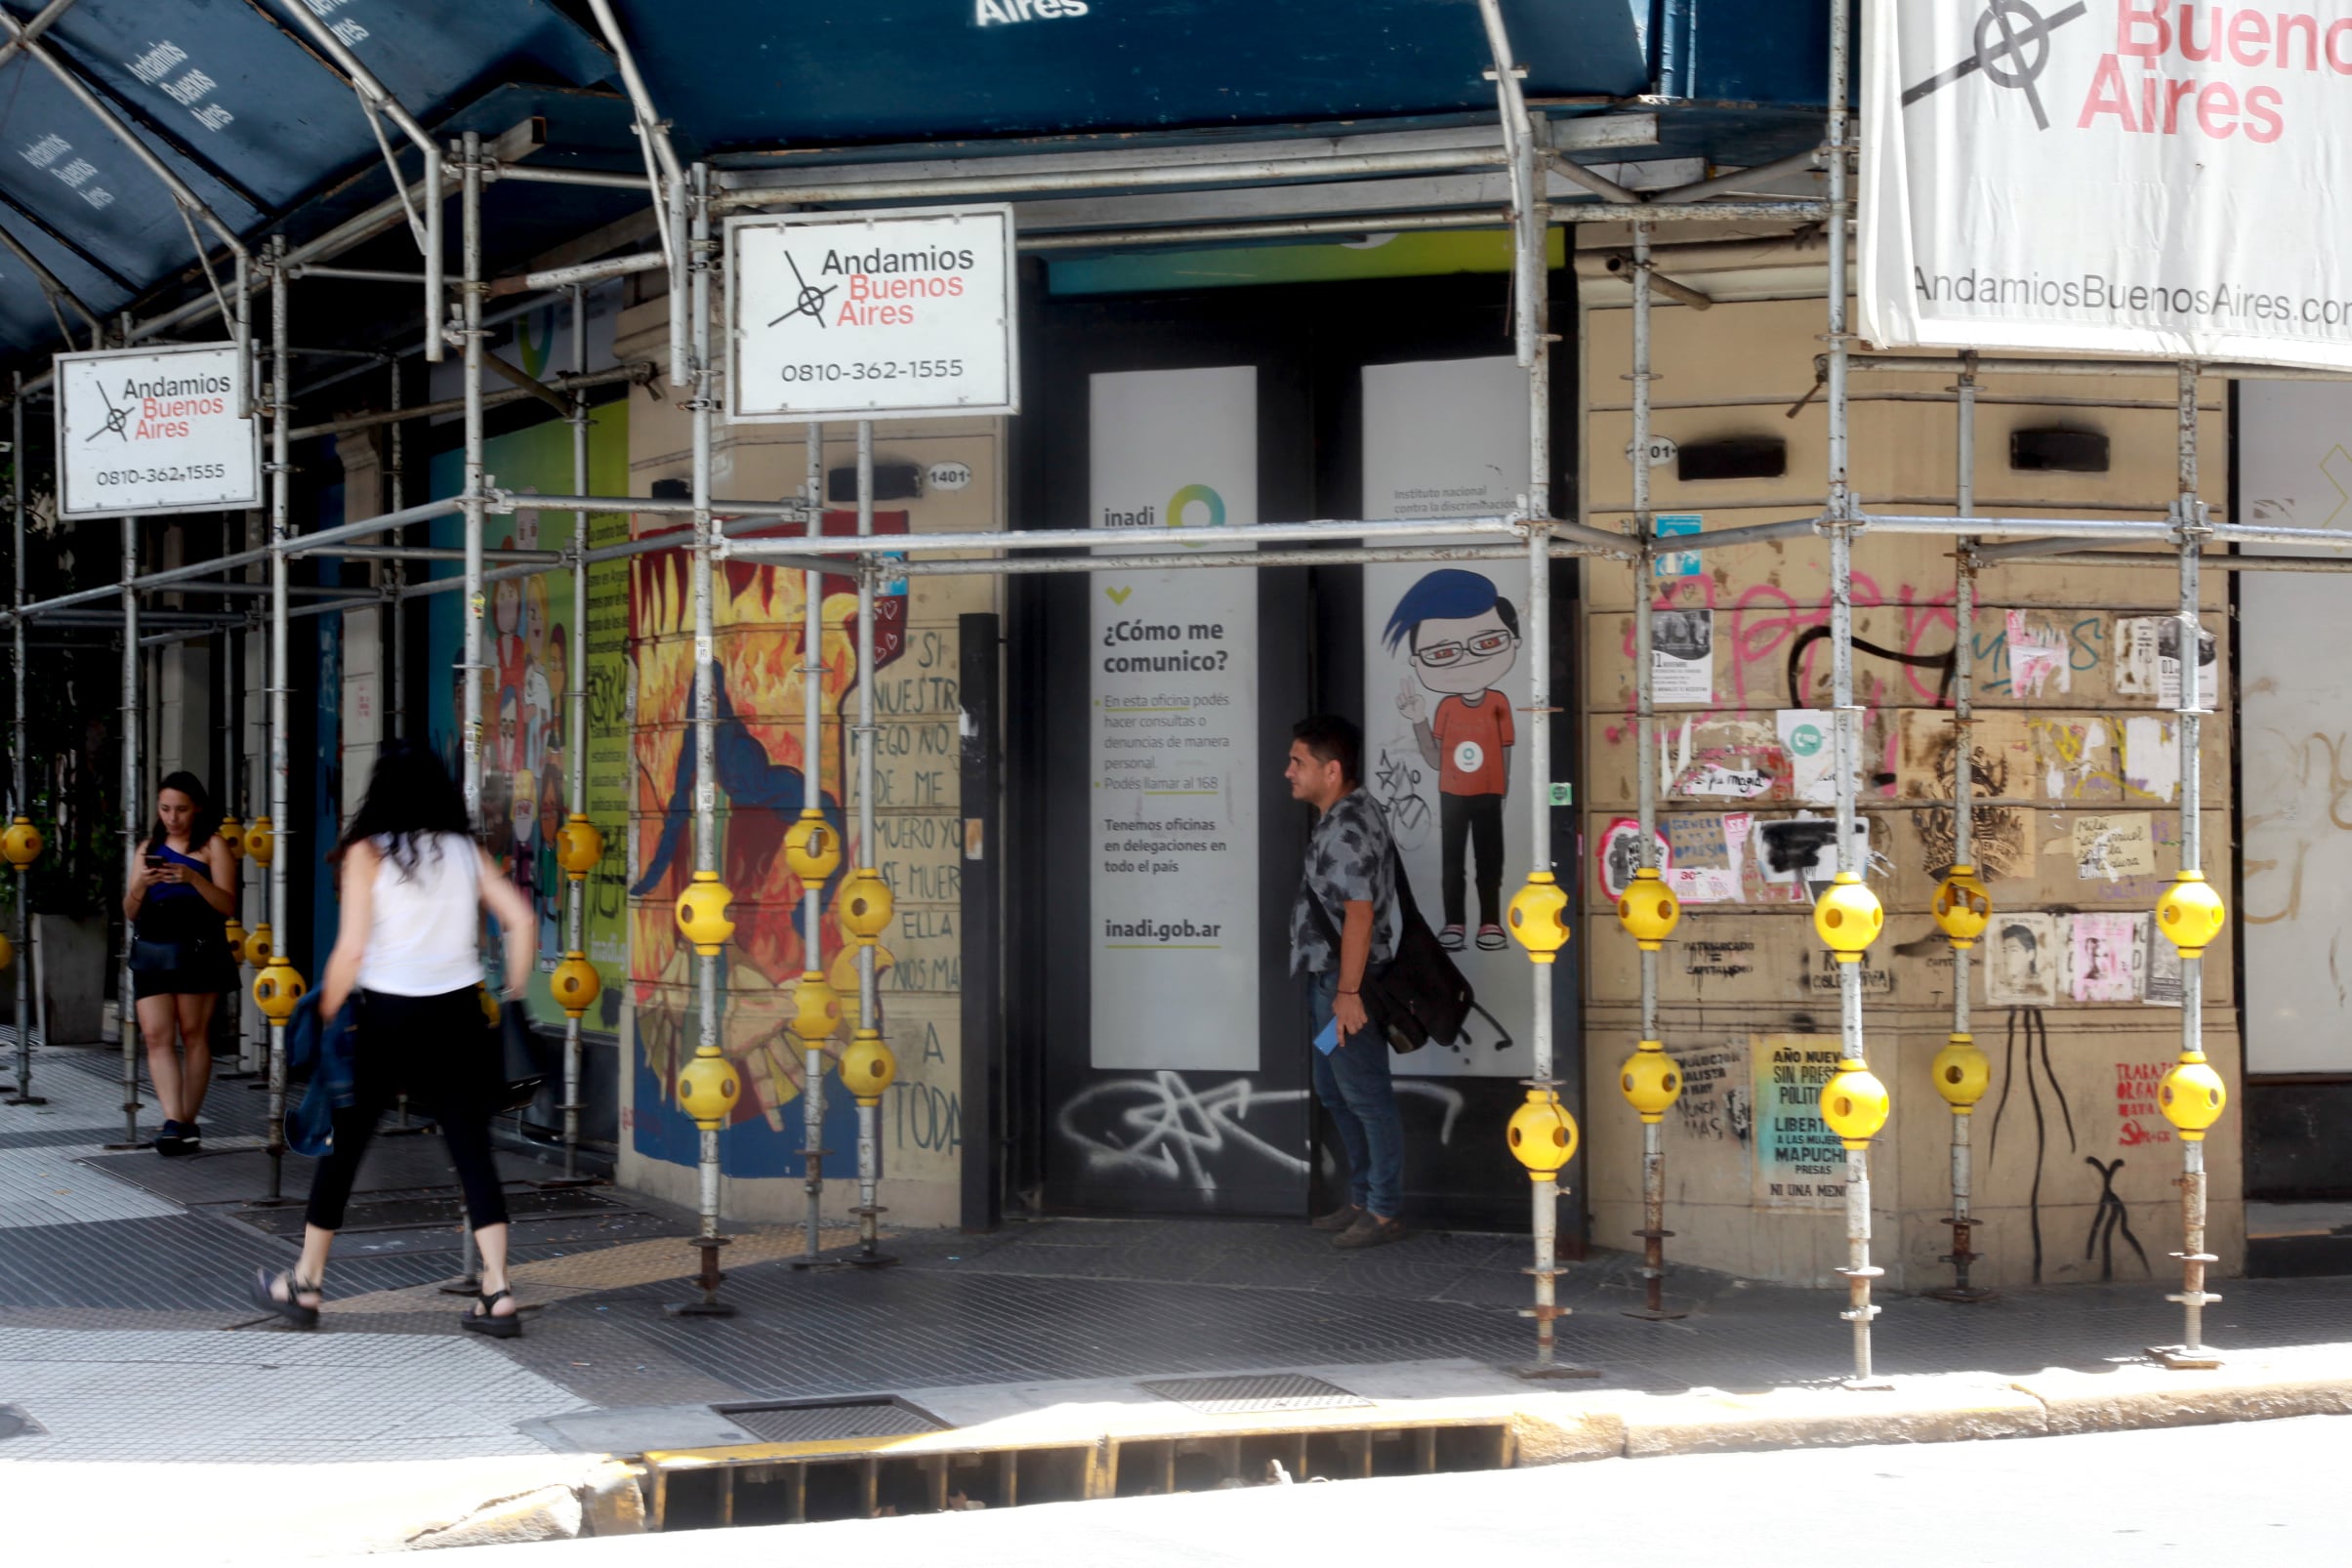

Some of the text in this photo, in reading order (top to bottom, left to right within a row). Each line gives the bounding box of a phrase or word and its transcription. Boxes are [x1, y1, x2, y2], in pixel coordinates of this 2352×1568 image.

[124, 39, 187, 86] Andamios
[159, 68, 218, 106] Buenos
[2077, 53, 2286, 144] Aires
[190, 103, 234, 132] Aires
[821, 244, 974, 275] Andamios
[849, 273, 964, 301] Buenos
[837, 300, 915, 327] Aires
[782, 358, 964, 382] 0810-362-1555
[123, 373, 231, 400] Andamios
[143, 396, 224, 420] Buenos
[135, 419, 189, 439] Aires
[97, 463, 226, 486] 0810-362-1555
[929, 471, 968, 483] 1401
[1394, 486, 1487, 500] Instituto nacional
[1104, 506, 1155, 527] inadi
[1394, 502, 1428, 514] contra
[1429, 502, 1440, 513] la
[1103, 618, 1223, 646] ¿Cómo me
[1103, 649, 1228, 673] comunico?
[1104, 694, 1229, 709] En esta oficina podés
[1103, 715, 1207, 727] hacer consultas o
[919, 723, 950, 756] NO
[1103, 735, 1230, 749] denuncias de manera
[1103, 757, 1159, 771] personal.
[915, 770, 945, 806] ME
[1103, 777, 1140, 790] Podés
[1143, 777, 1179, 790] llamar
[1182, 777, 1194, 789] al
[874, 818, 933, 849] MUERO
[1104, 818, 1216, 832] Tenemos oficinas
[1104, 840, 1227, 855] en delegaciones en
[1104, 860, 1178, 876] todo el país
[902, 912, 953, 939] ELLA
[1104, 919, 1221, 942] inadi.gob.ar
[924, 1021, 945, 1066] A
[1773, 1047, 1801, 1063] AÑO
[1774, 1065, 1795, 1084] SIN
[1787, 1135, 1804, 1144] LAS
[1795, 1165, 1833, 1175] PRESAS
[1770, 1184, 1783, 1196] NI
[1788, 1184, 1813, 1197] UNA
